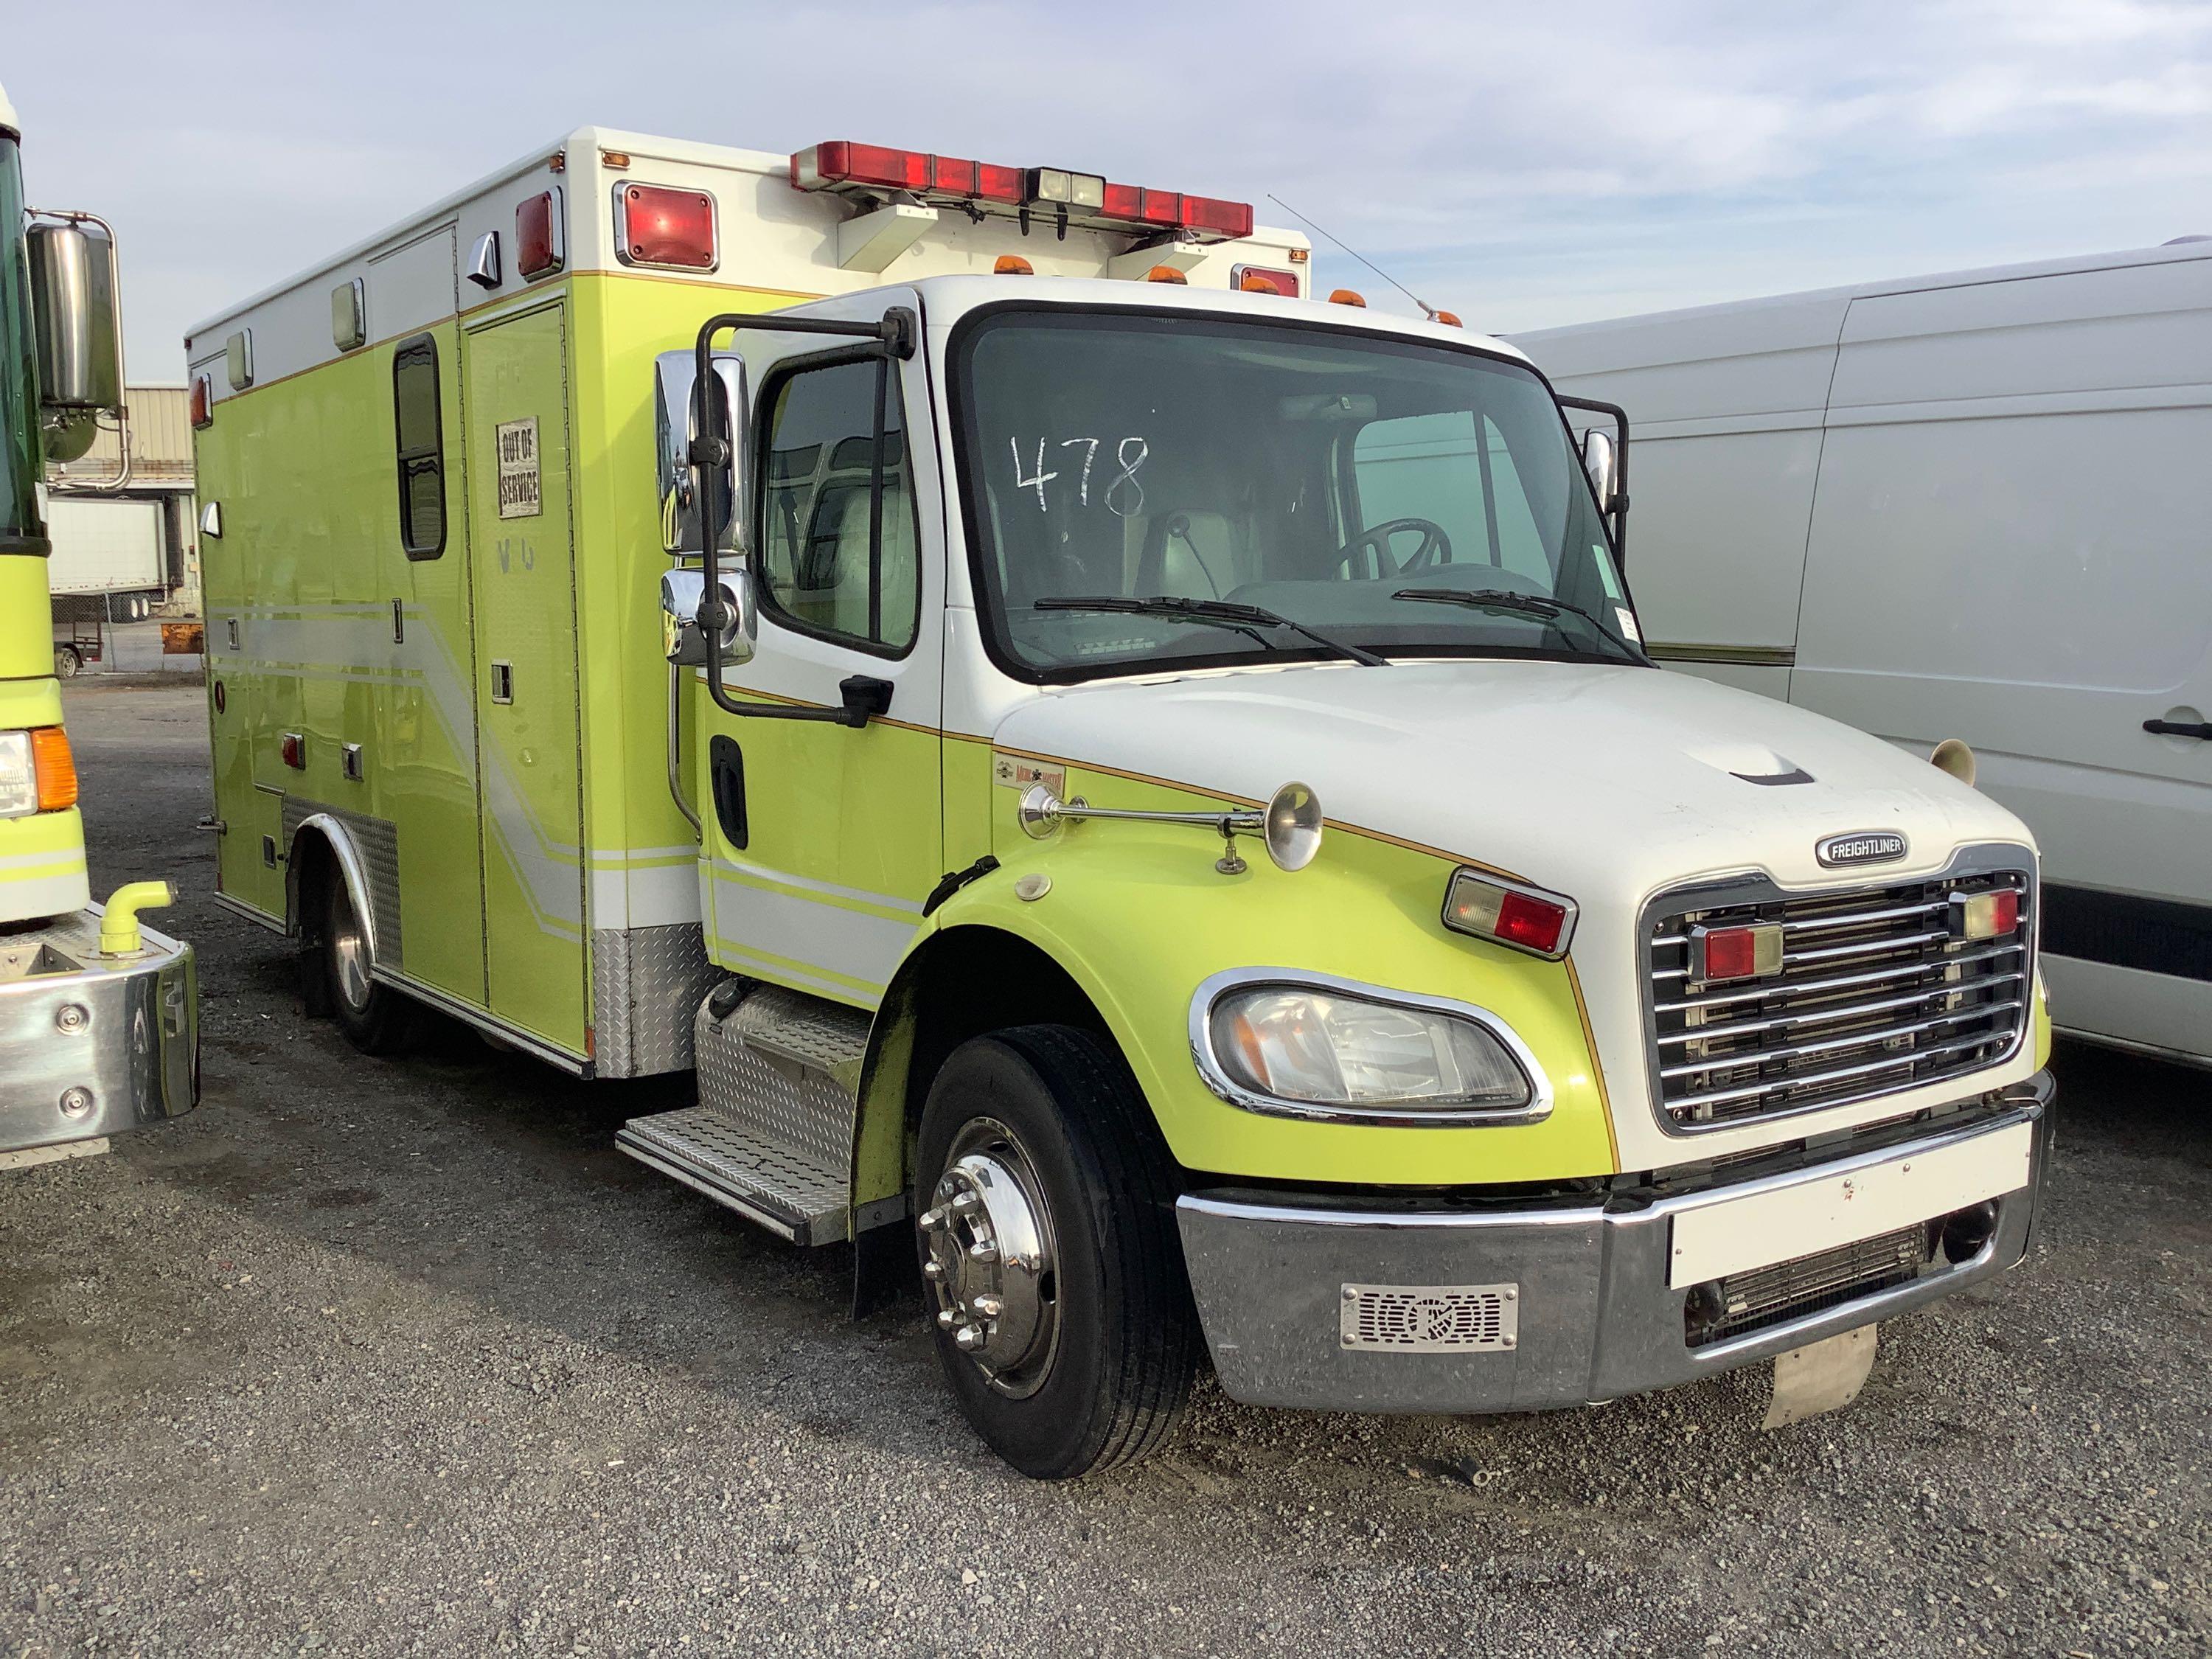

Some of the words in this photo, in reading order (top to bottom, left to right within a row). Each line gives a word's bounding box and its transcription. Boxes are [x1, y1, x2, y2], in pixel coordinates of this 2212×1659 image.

[503, 431, 520, 462] OUT
[521, 428, 532, 459] OF
[501, 472, 538, 505] SERVICE
[1009, 436, 1149, 518] 478
[1832, 838, 1901, 859] FREIGHTLINER
